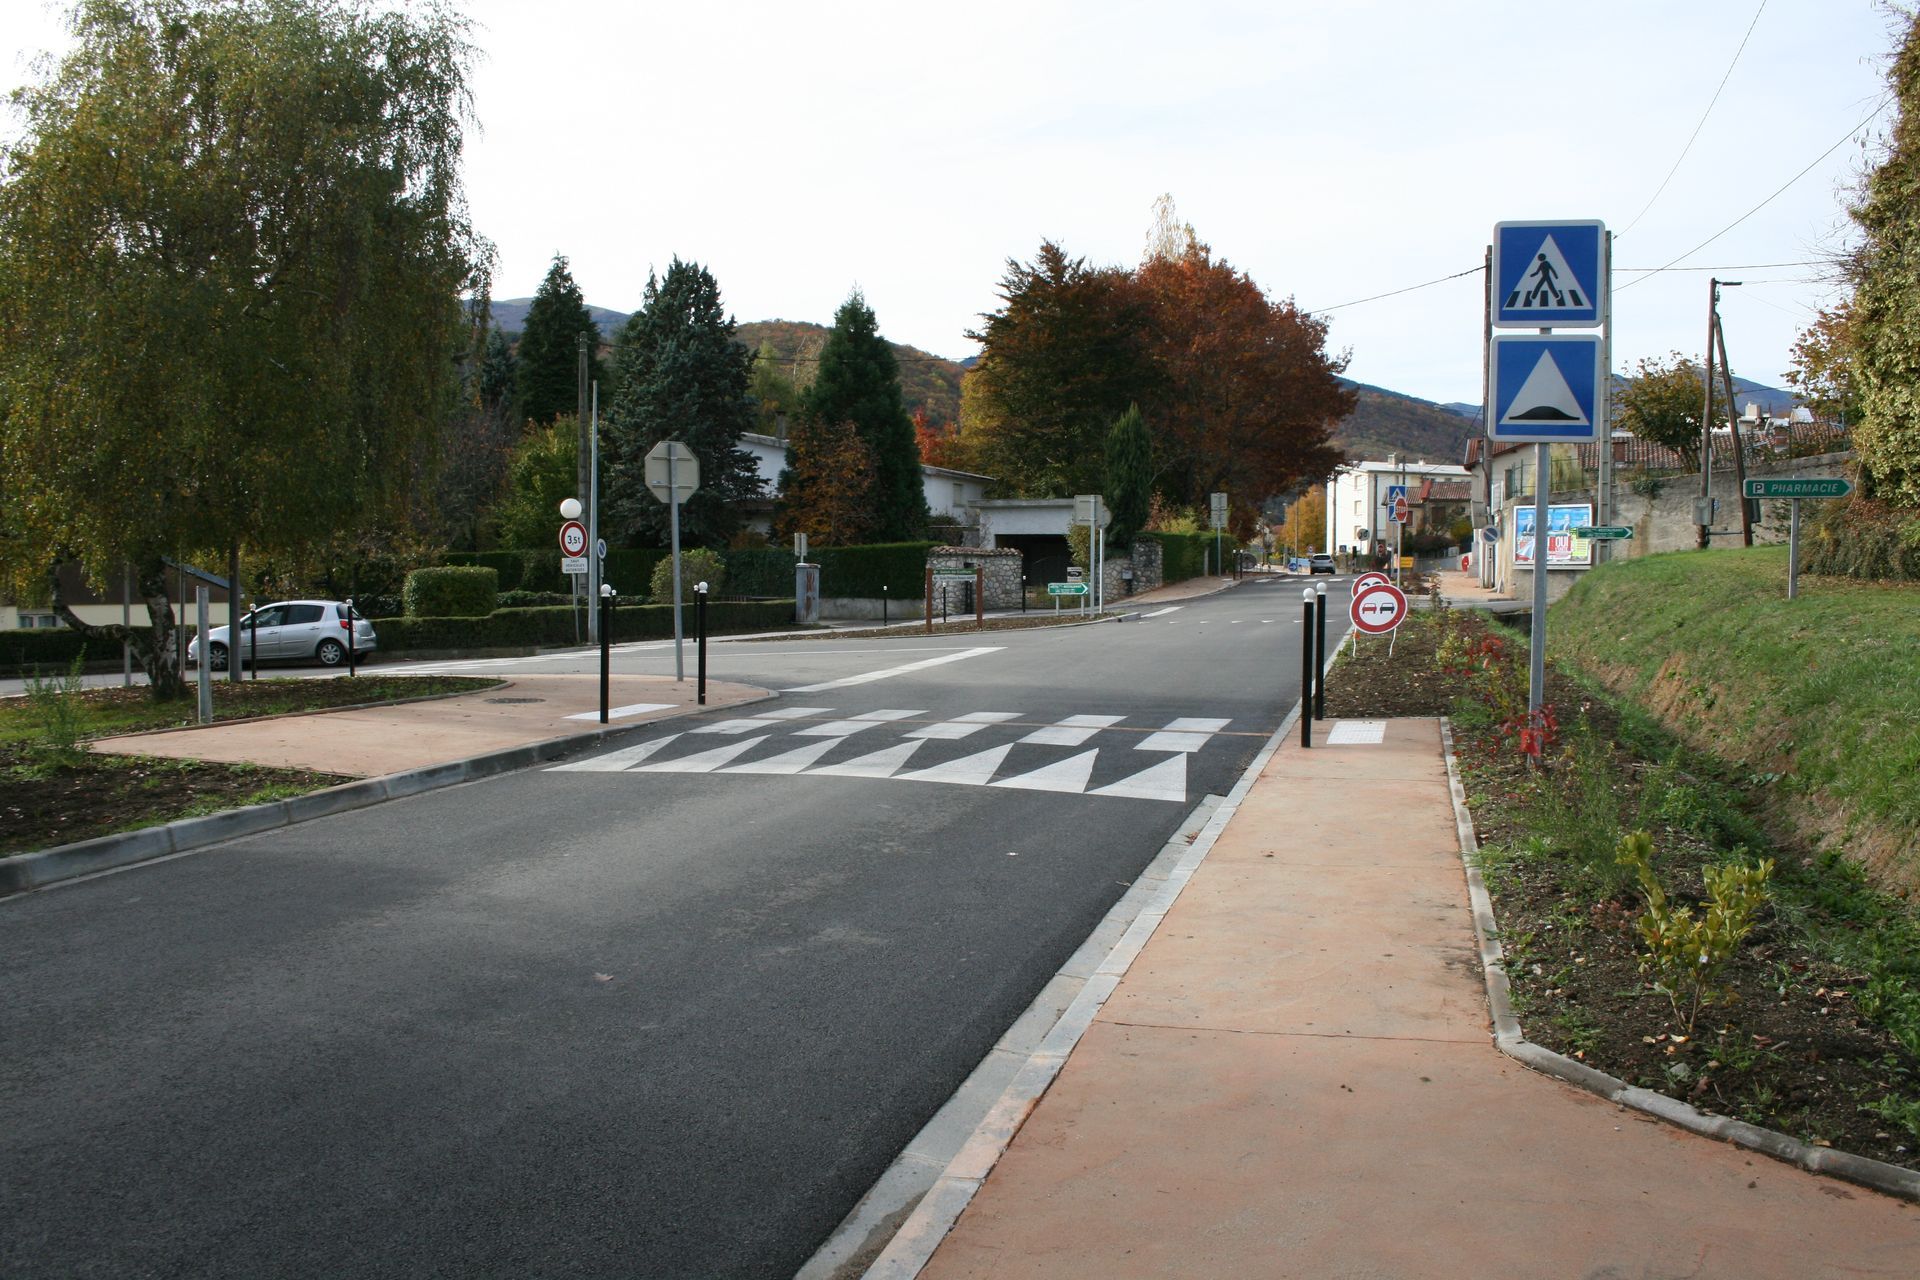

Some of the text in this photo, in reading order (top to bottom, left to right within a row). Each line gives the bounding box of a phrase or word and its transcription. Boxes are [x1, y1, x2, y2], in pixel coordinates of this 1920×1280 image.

[1771, 483, 1839, 493] PHARMACIE
[1396, 505, 1406, 513] STOP
[567, 535, 581, 545] 3,5t
[1555, 536, 1569, 547] OUI
